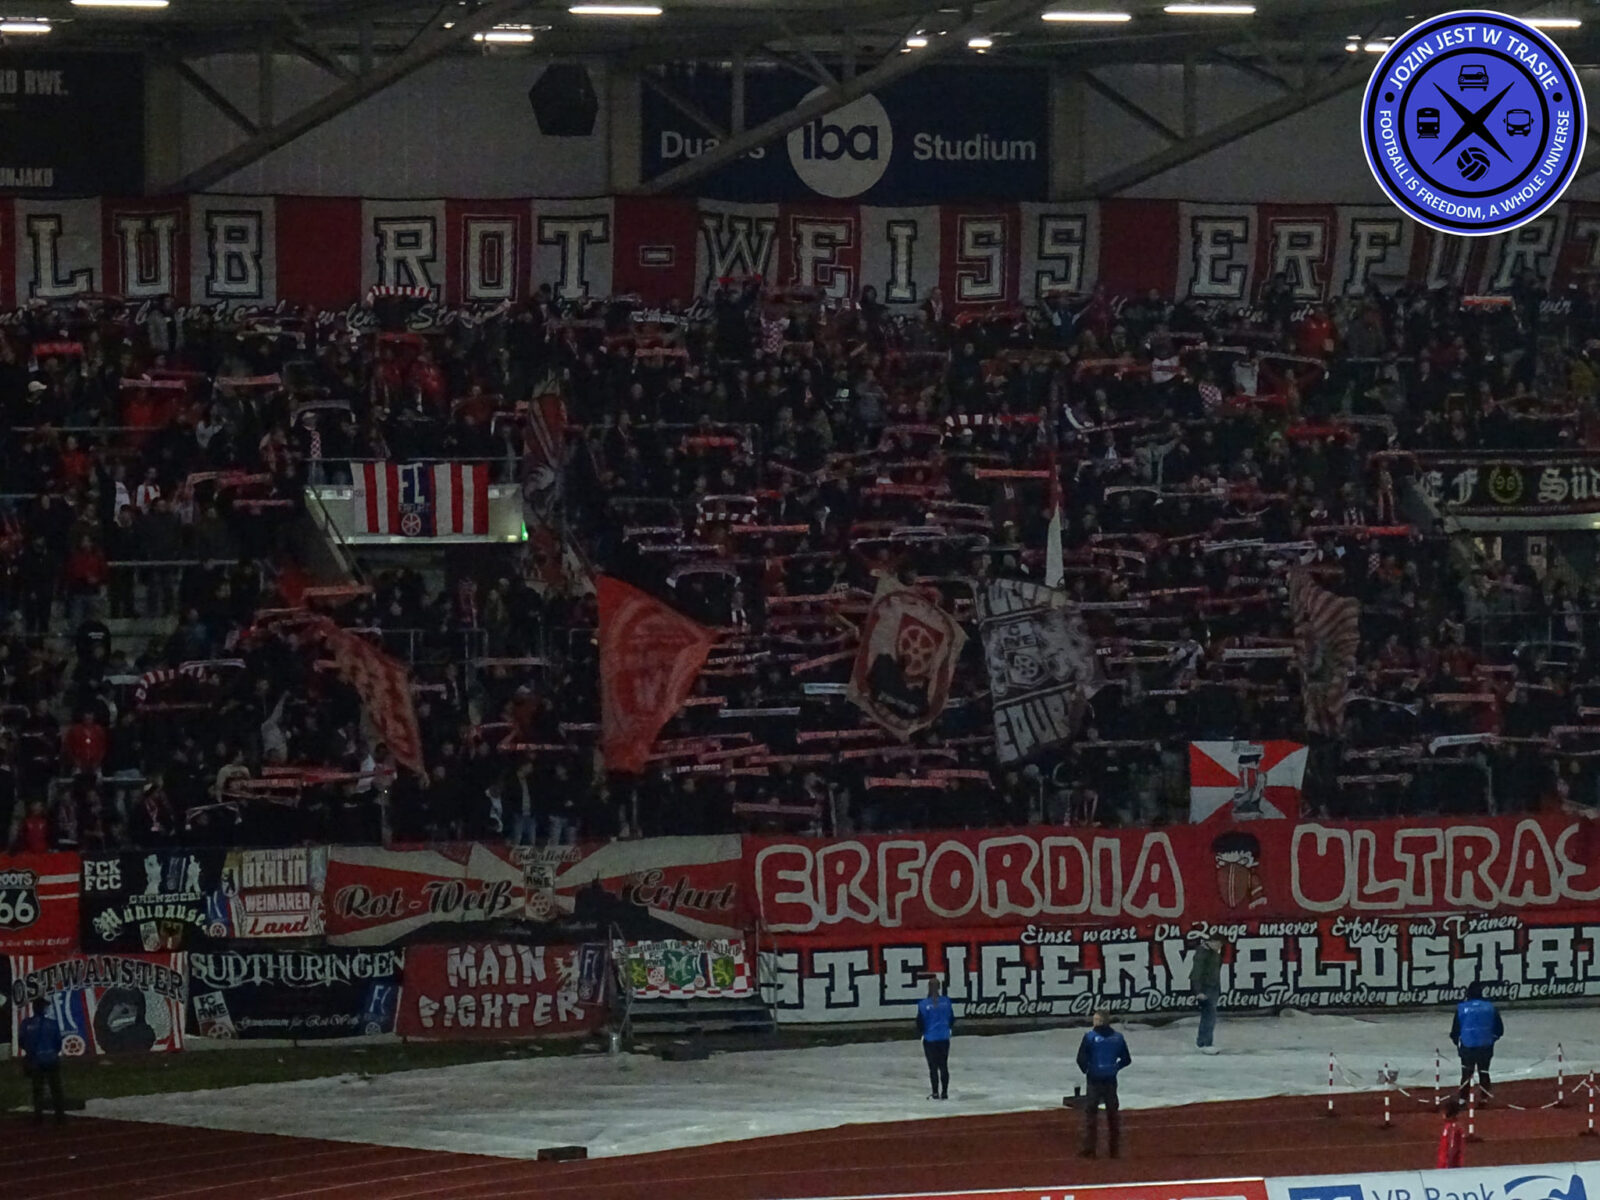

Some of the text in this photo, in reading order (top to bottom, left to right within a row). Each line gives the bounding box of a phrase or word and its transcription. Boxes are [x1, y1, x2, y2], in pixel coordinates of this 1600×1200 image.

[802, 118, 879, 160] iba
[912, 132, 1036, 161] Studium
[84, 859, 121, 876] FCK
[85, 874, 122, 892] FCC
[754, 818, 1600, 932] ERFORDIA ULTRAS
[244, 891, 311, 914] WEIMARER
[631, 868, 737, 911] Erfurt
[249, 916, 308, 935] Land
[1020, 923, 1072, 944] Einst
[1083, 926, 1137, 942] warst
[1154, 922, 1181, 942] Du
[1259, 920, 1318, 937] unserer
[1331, 915, 1399, 944] Erfolge
[1408, 917, 1436, 936] und
[1443, 913, 1524, 940] Tränen,
[446, 945, 547, 987] MAIN
[965, 991, 1007, 1015] nach
[1018, 994, 1053, 1014] dem
[1070, 992, 1131, 1016] Glanz
[1217, 989, 1258, 1008] alten
[1330, 982, 1387, 1004] werden
[1399, 988, 1427, 1004] wir
[1481, 980, 1519, 1000] ewig
[1532, 976, 1585, 997] sehnen
